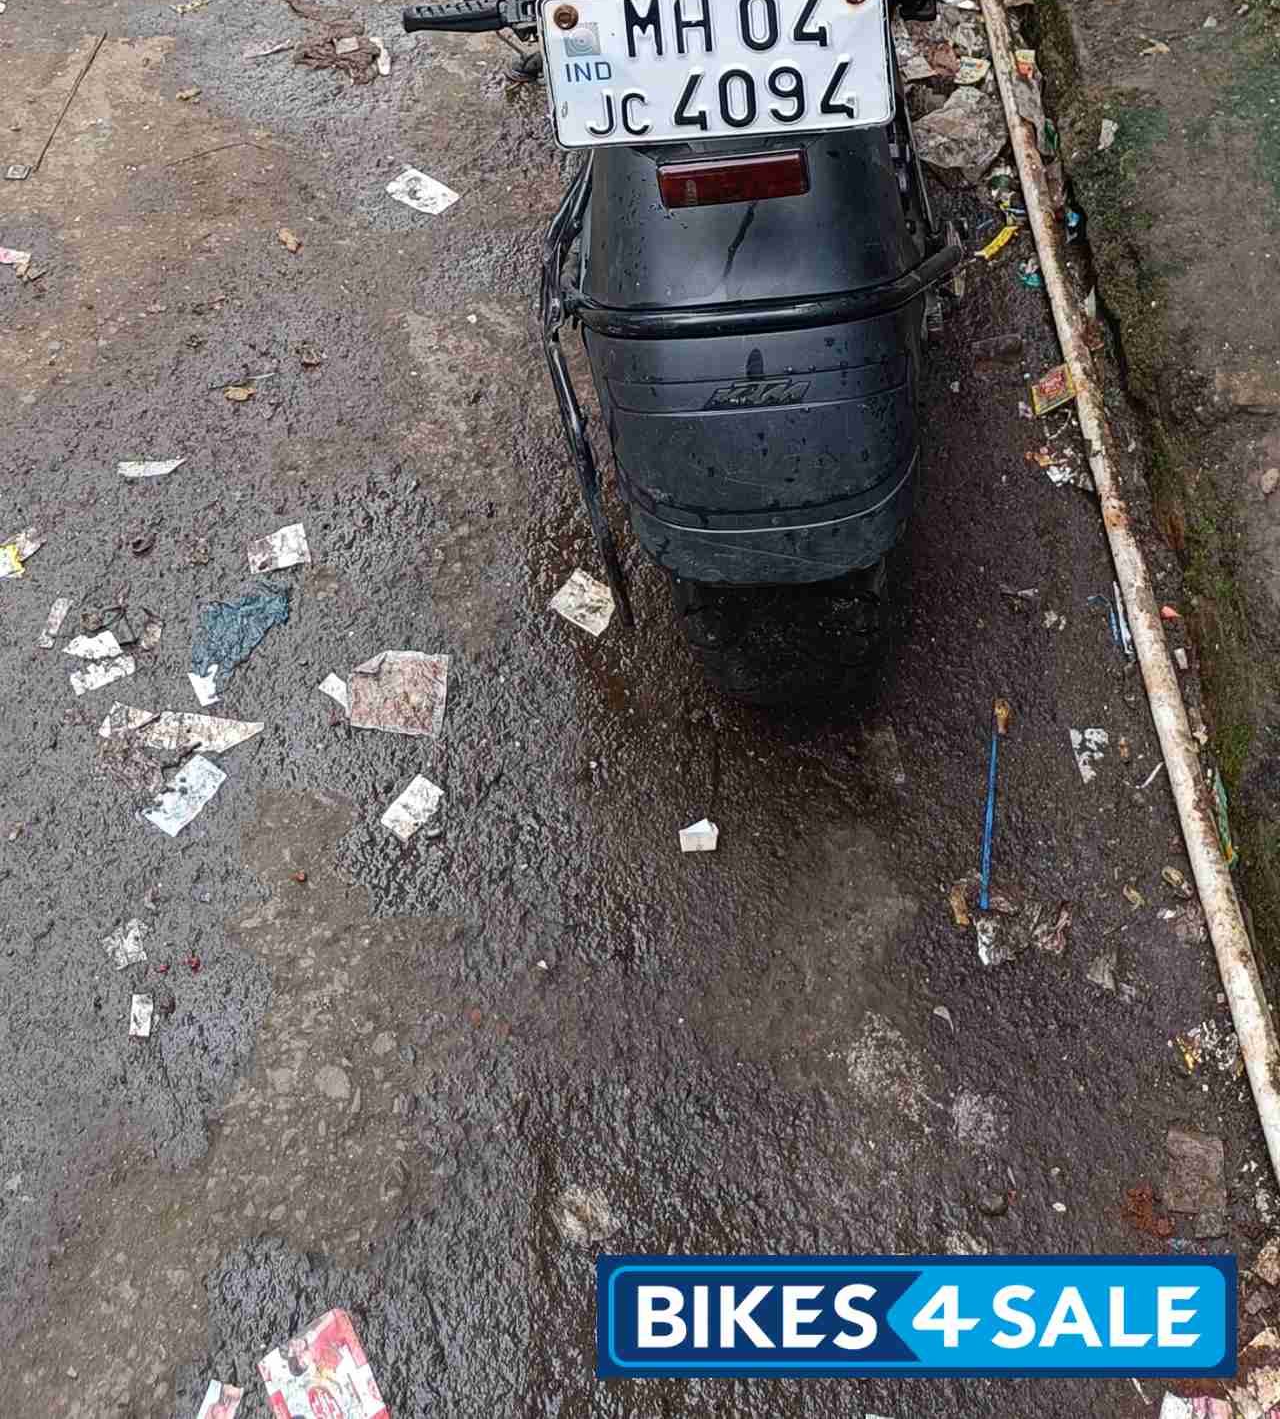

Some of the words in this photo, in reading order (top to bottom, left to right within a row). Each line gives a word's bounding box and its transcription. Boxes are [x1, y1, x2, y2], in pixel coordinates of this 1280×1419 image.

[565, 61, 612, 82] IND
[588, 92, 649, 135] JC
[673, 61, 855, 131] 4094
